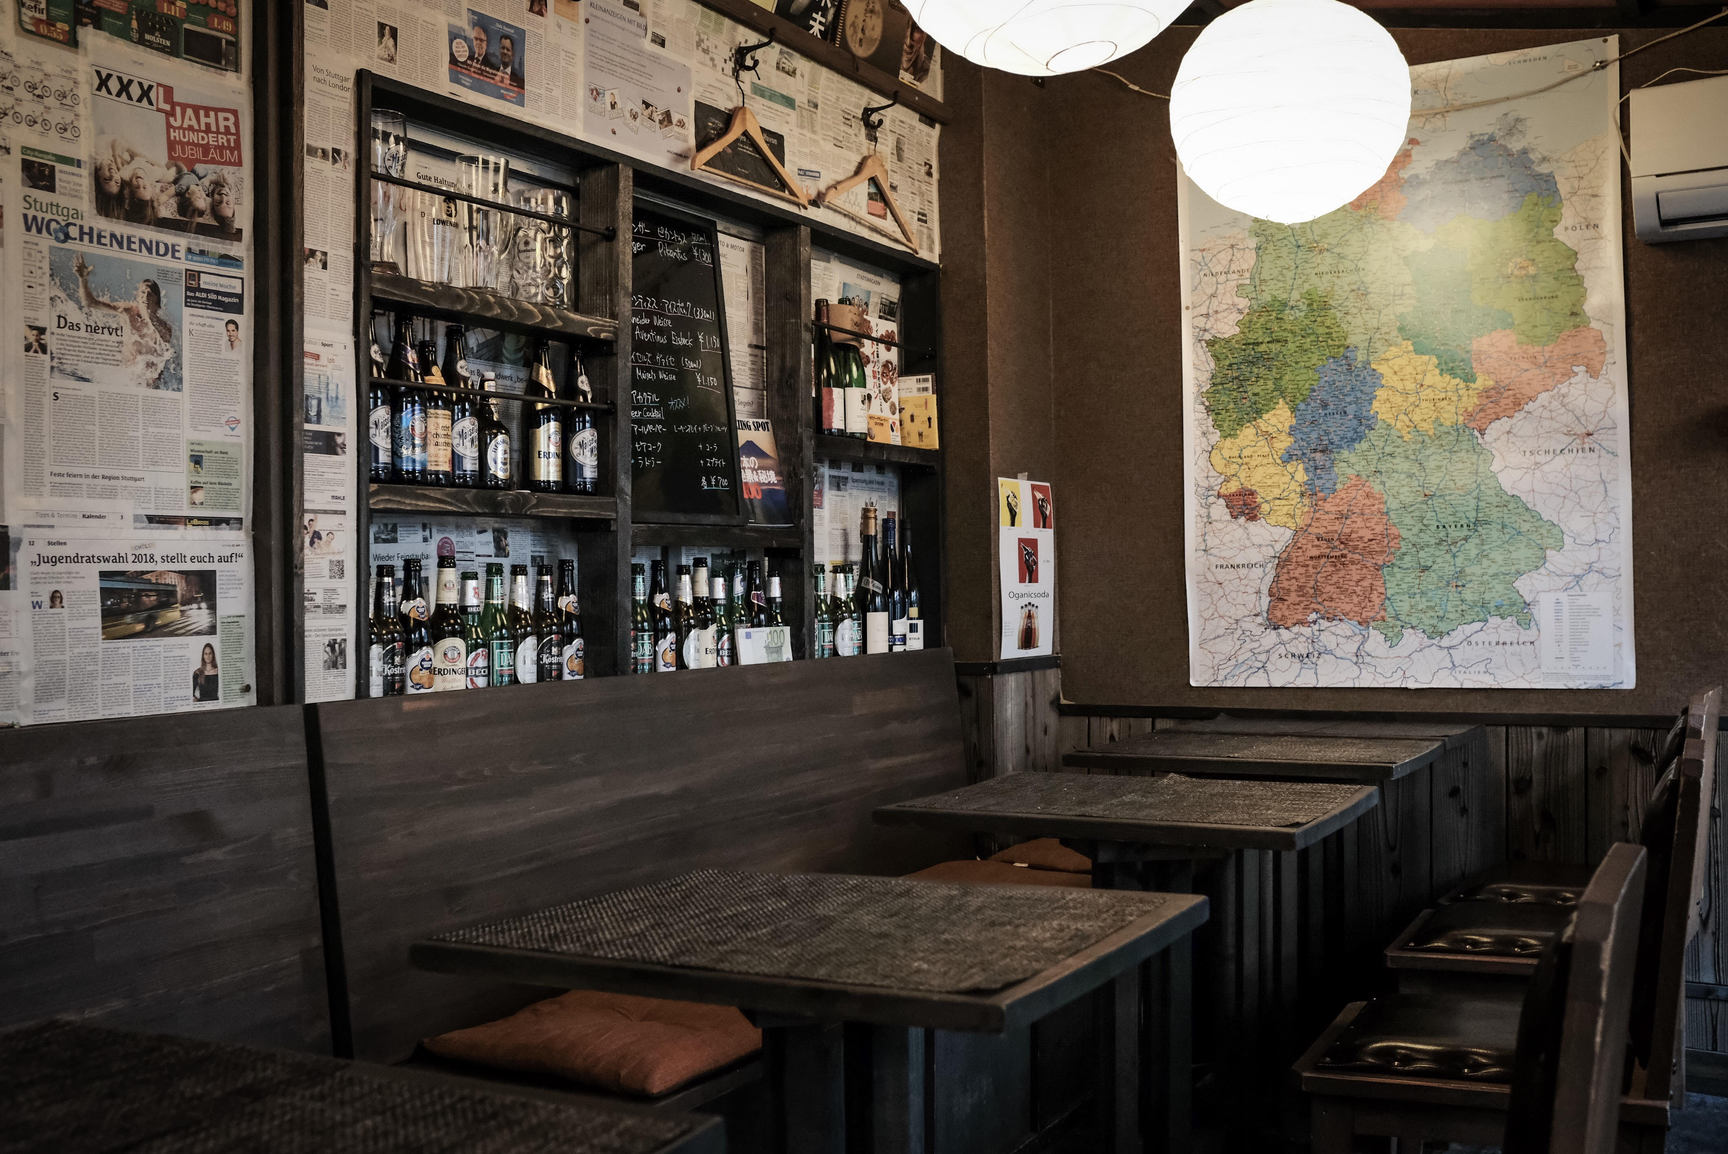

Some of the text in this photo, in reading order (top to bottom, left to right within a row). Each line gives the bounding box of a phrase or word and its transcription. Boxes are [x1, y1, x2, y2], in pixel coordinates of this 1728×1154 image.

[169, 106, 237, 134] JAHR
[170, 128, 237, 148] HUNDERT
[172, 144, 239, 162] JUBILÄUM
[416, 172, 433, 183] Gute
[1564, 223, 1600, 232] POLEN
[23, 213, 181, 260] WOCHENENDE
[56, 315, 124, 338] Das nervt!
[752, 420, 770, 433] SPOT
[1521, 446, 1596, 457] TSCHECHIEN
[161, 553, 188, 564] stellt
[190, 553, 215, 564] euch
[372, 554, 395, 562] Wieder
[1215, 562, 1264, 570] FRANKREICH
[1008, 590, 1050, 601] Oganicsoda
[768, 629, 785, 647] 100
